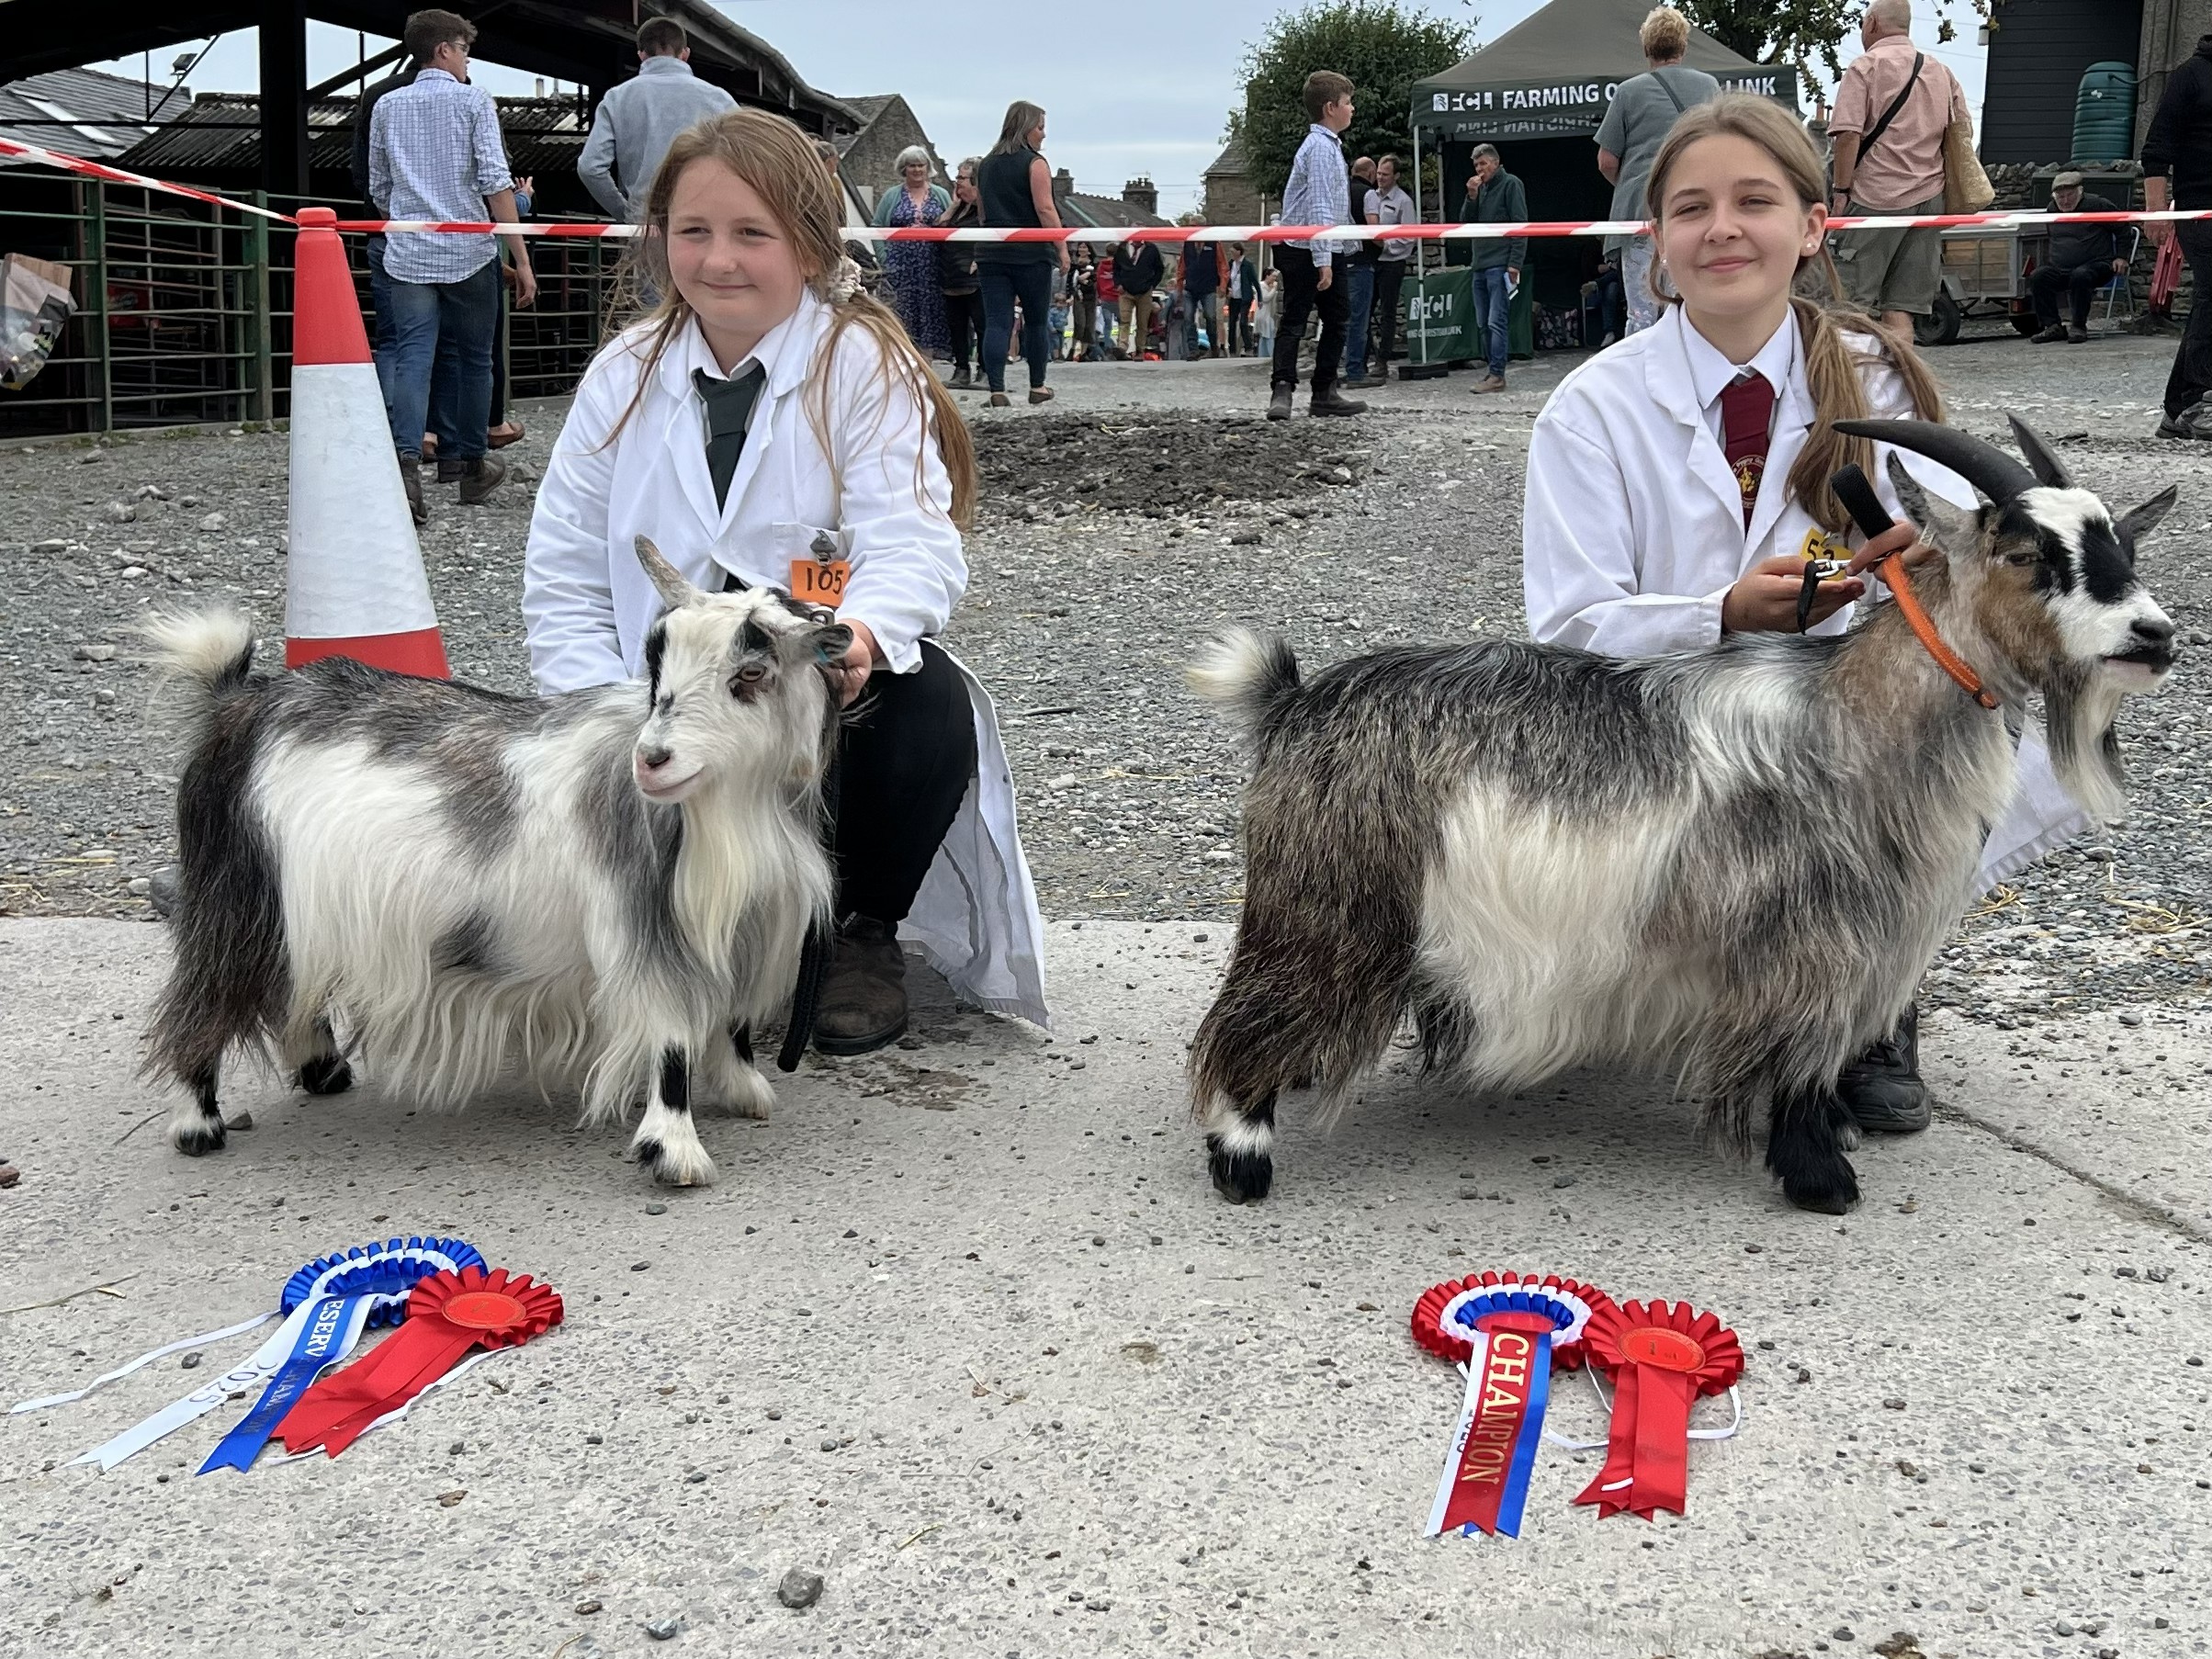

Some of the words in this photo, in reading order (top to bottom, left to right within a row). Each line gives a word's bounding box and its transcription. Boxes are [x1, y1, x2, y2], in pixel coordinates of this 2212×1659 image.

[1502, 84, 1600, 109] FARMING
[807, 567, 843, 595] 105
[303, 1298, 345, 1359] ESERV
[188, 1359, 279, 1404] 2025
[1461, 1332, 1530, 1485] CHAMPION
